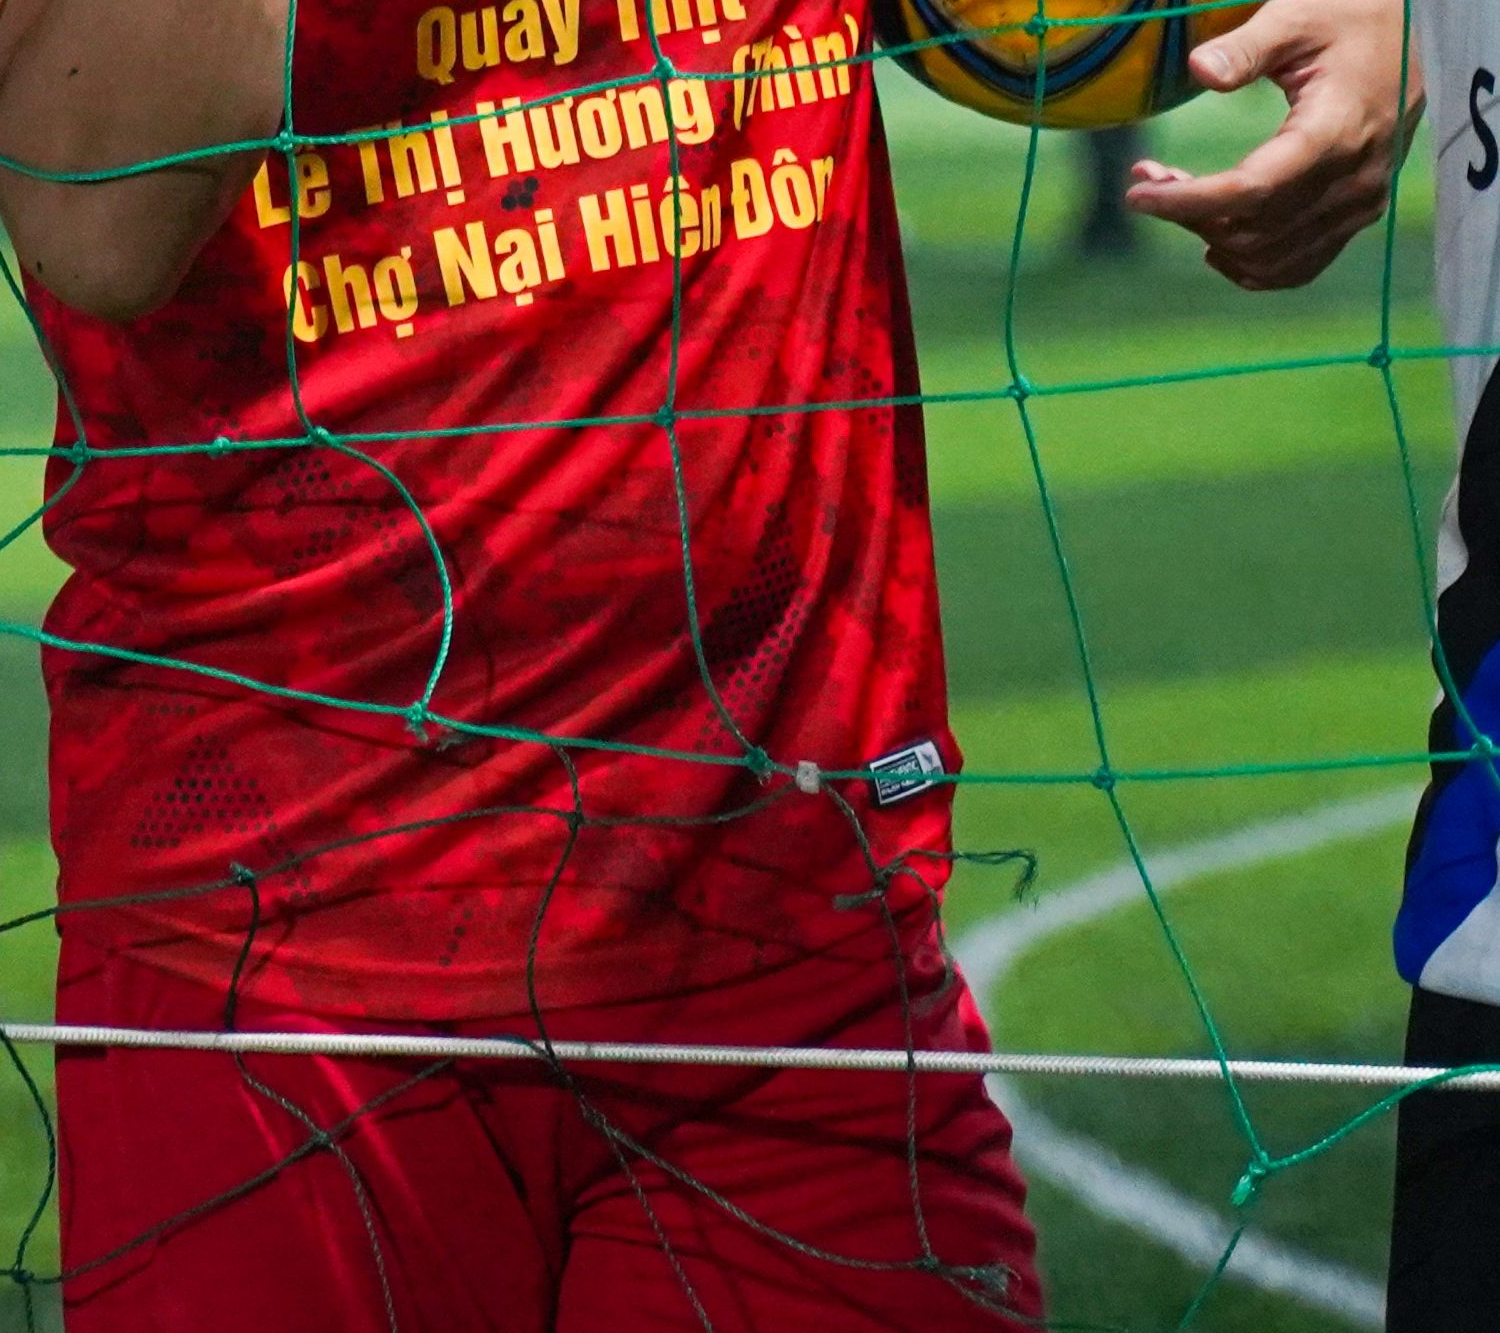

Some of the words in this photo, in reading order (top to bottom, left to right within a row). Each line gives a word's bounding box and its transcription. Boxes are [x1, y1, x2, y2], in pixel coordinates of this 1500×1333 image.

[347, 109, 466, 206] Thị
[476, 76, 715, 178] Hương
[282, 245, 419, 343] Chợ
[433, 208, 566, 308] Nại
[578, 175, 721, 273] Hiên
